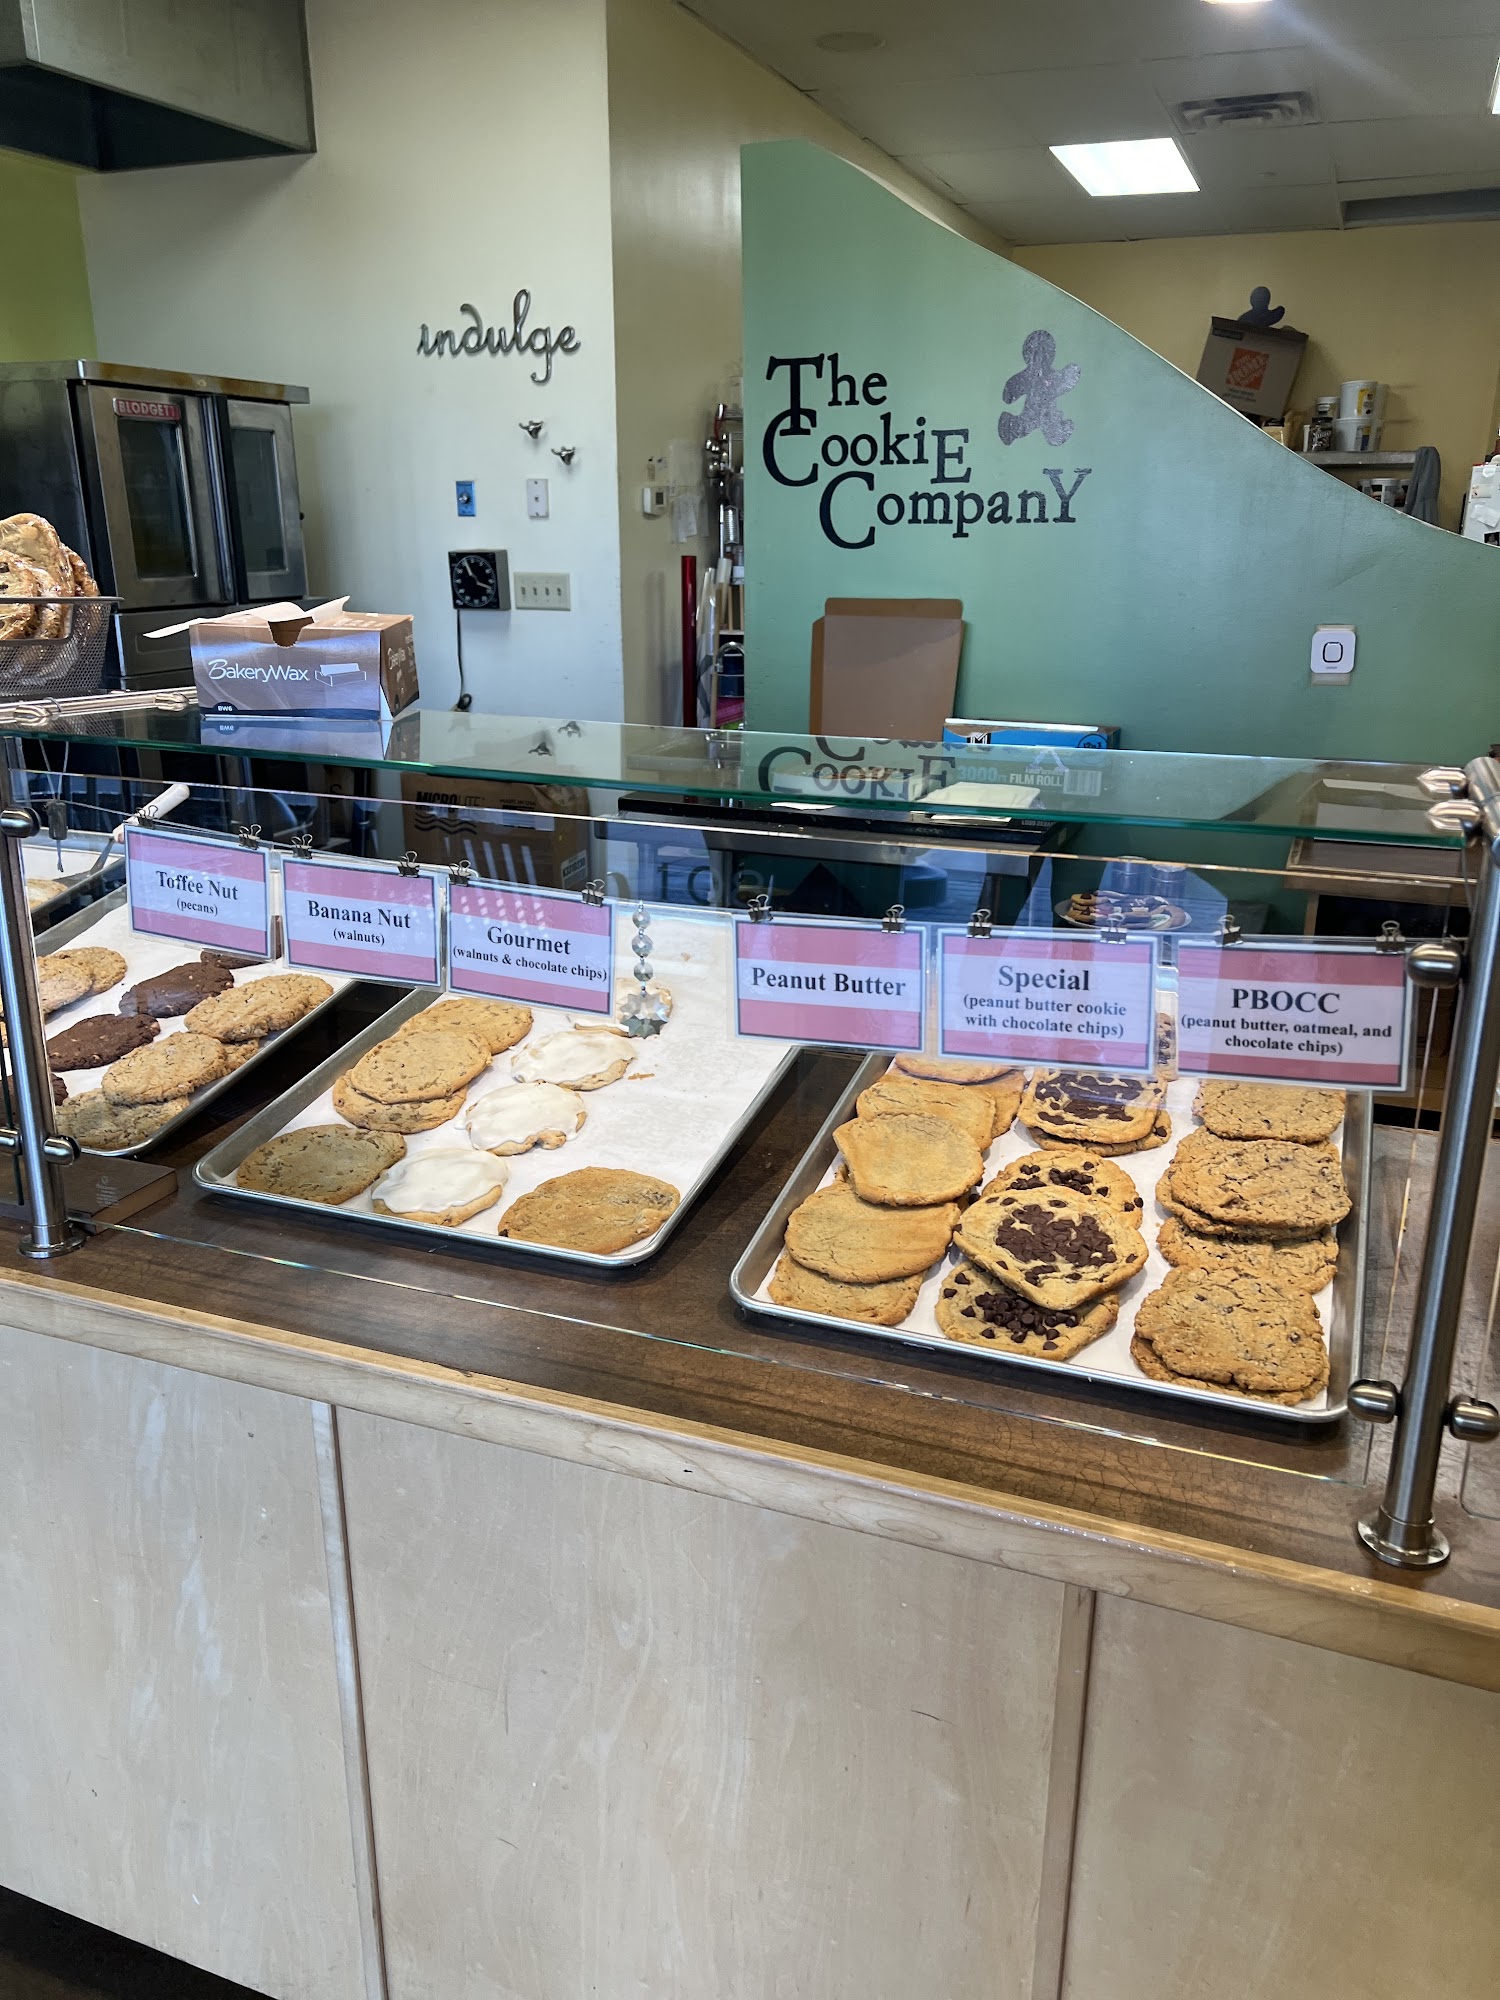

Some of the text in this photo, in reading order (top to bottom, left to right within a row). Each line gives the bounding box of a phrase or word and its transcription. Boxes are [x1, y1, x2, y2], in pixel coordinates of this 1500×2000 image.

[417, 289, 581, 384] indulge
[766, 353, 887, 436] The
[118, 401, 176, 417] BLODGETT
[819, 468, 1092, 549] CompanY
[208, 659, 309, 682] BakeryWax
[1009, 773, 1034, 785] FILM
[1036, 775, 1063, 787] ROLL
[156, 870, 239, 900] Toffee Nut
[176, 897, 218, 916] (pecans)
[308, 900, 411, 929] Banana Nut
[333, 928, 385, 946] (walnuts)
[487, 926, 571, 955] Gourmet
[453, 946, 608, 982] (walnuts & chocolate chips)
[751, 967, 906, 997] Peanut Butter
[999, 966, 1091, 993] Special
[963, 994, 1127, 1016] (peanut butter cookie
[1231, 987, 1341, 1014] PBOCC
[965, 1015, 1124, 1039] with chocolate chips)
[1181, 1014, 1392, 1038] (peanut butter, oatmeal, and
[1225, 1035, 1343, 1056] chocolate chips)
